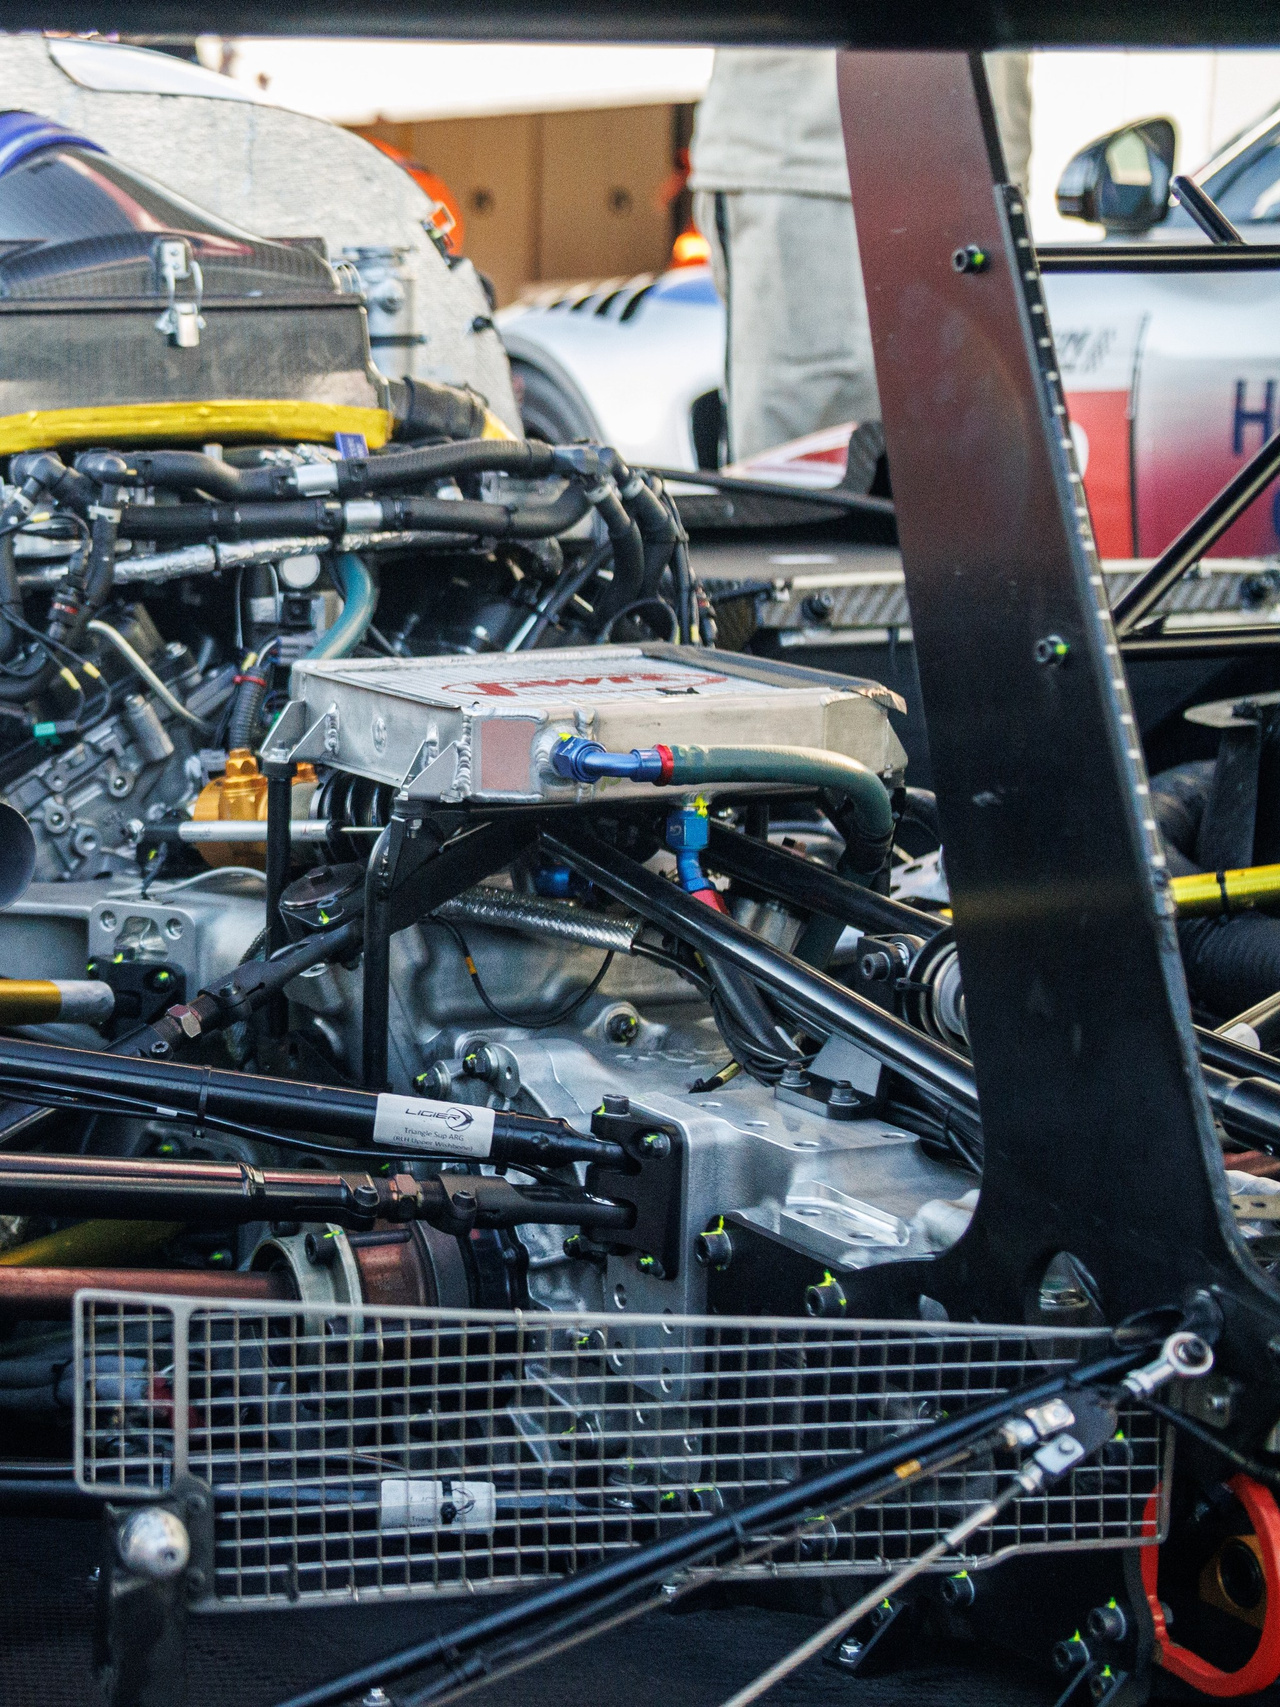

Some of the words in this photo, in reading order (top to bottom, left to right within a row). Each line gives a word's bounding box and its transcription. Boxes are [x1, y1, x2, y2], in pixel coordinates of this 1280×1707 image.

[405, 1108, 461, 1121] LIGIER
[404, 1127, 433, 1138] Triangle
[434, 1131, 448, 1140] Sup
[448, 1133, 465, 1142] ARG
